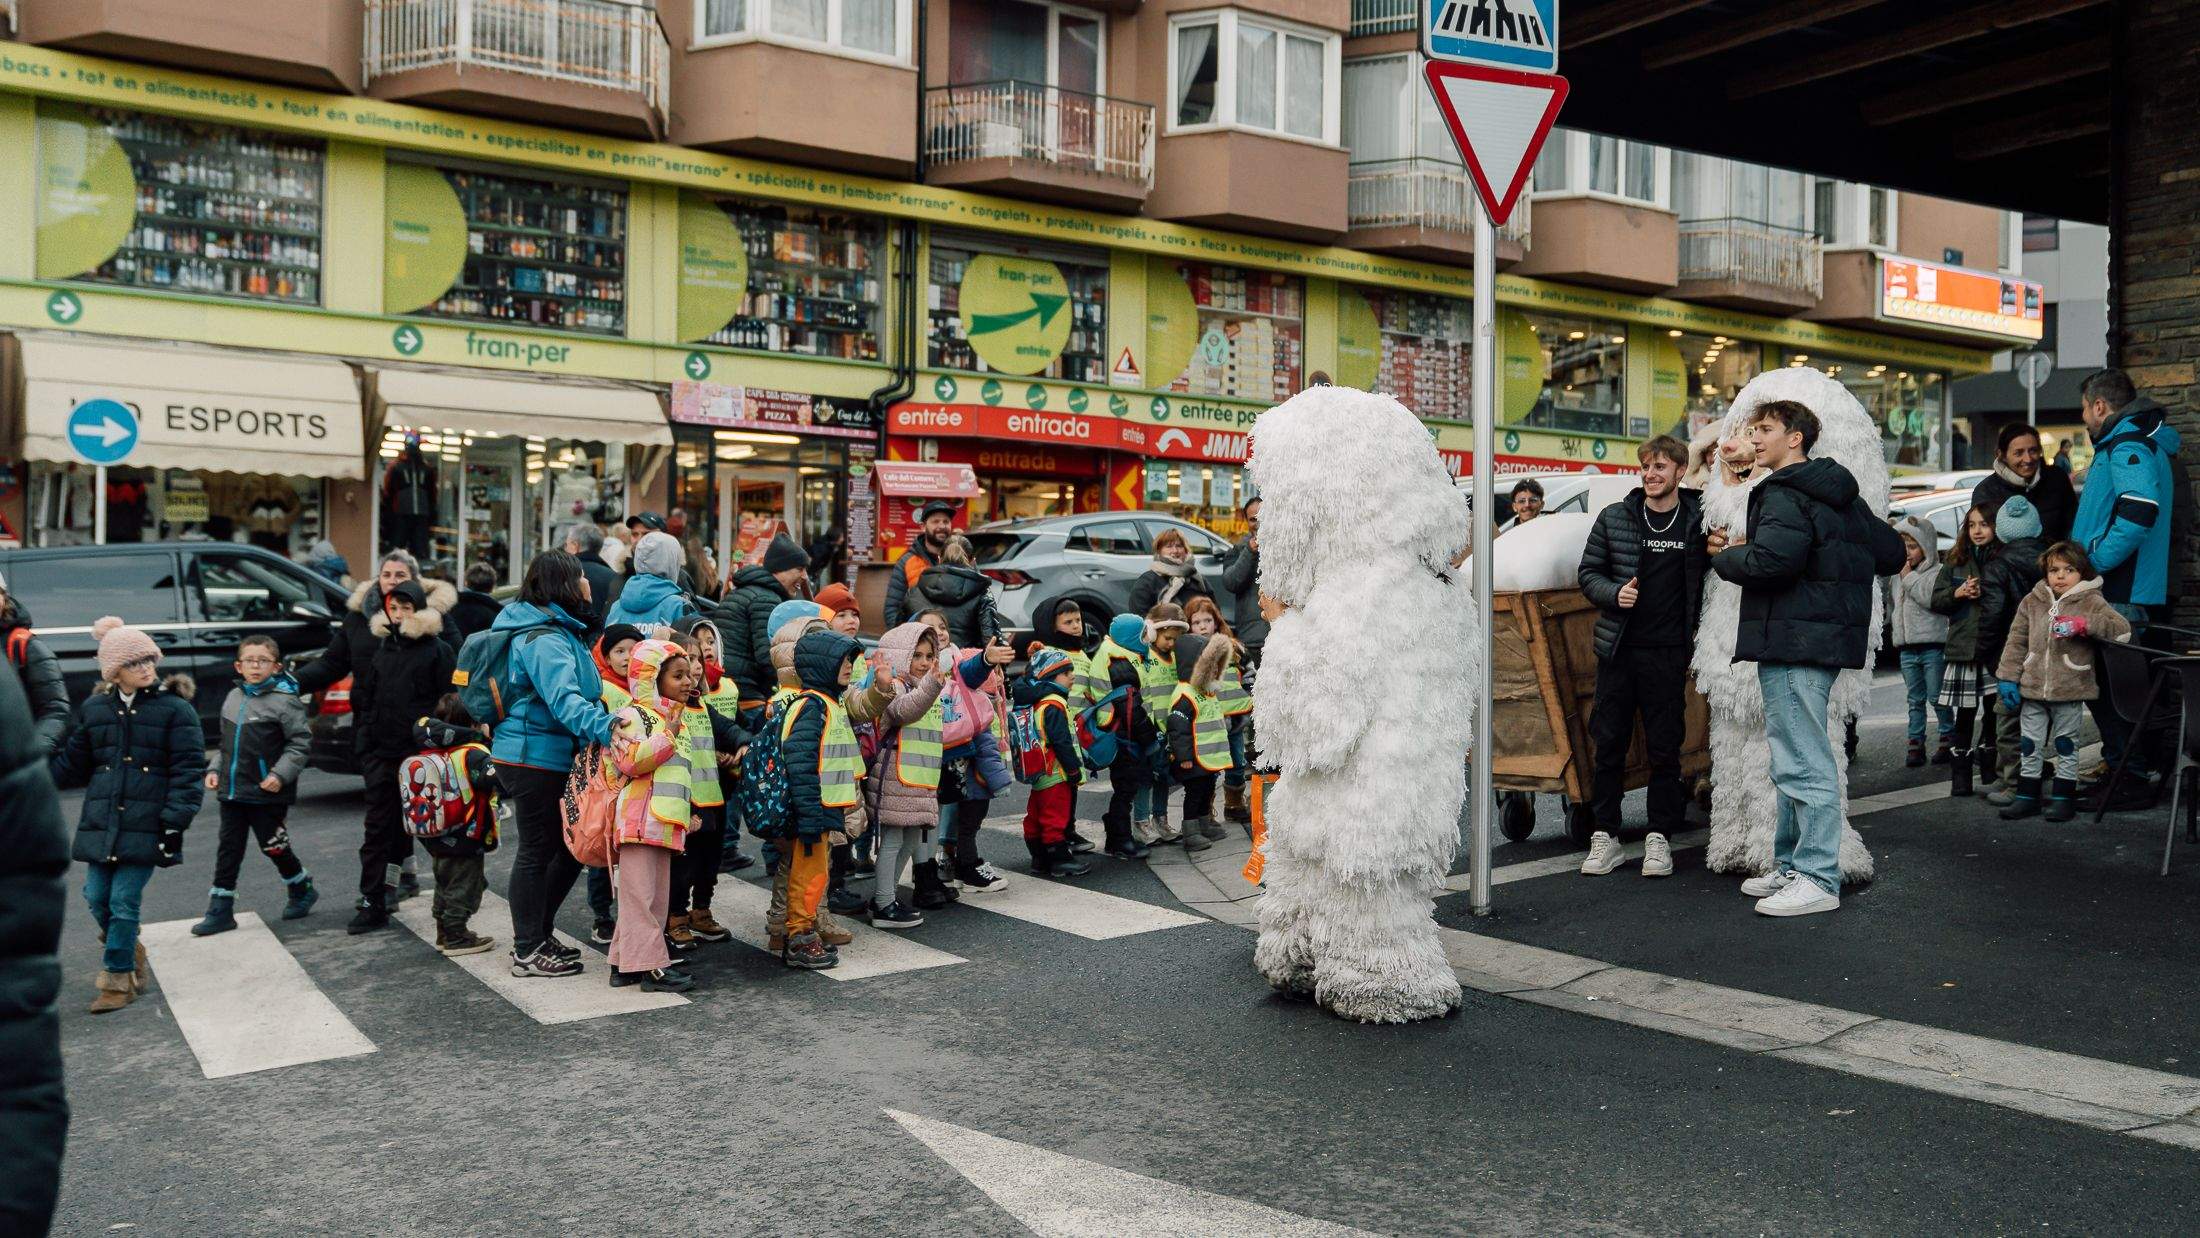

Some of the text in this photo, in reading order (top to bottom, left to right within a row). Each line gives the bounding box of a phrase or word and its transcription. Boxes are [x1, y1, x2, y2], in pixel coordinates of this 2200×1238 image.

[2, 56, 50, 77] bacs
[77, 68, 257, 108] tot en alimentació
[282, 99, 465, 139] tout en alimentation
[486, 134, 581, 156] especialitat
[587, 148, 606, 161] en
[748, 170, 815, 192] spécialité
[820, 183, 837, 196] en
[971, 204, 1031, 224] congelats
[1046, 215, 1147, 242] produits surgelés
[1161, 233, 1187, 247] cava
[1200, 238, 1228, 253] fleca
[1240, 243, 1304, 265] boulangerie
[998, 265, 1053, 286] fran-per
[1432, 271, 1475, 288] boucheri
[166, 404, 327, 440] ESPORTS
[764, 411, 791, 423] PIZZA
[898, 408, 963, 427] entrée
[1181, 403, 1233, 422] entrée
[1007, 413, 1090, 438] entrada
[1122, 427, 1146, 446] entrée
[1202, 432, 1249, 460] JMM
[978, 450, 1056, 472] entrada
[1647, 539, 1686, 550] KOOPLE
